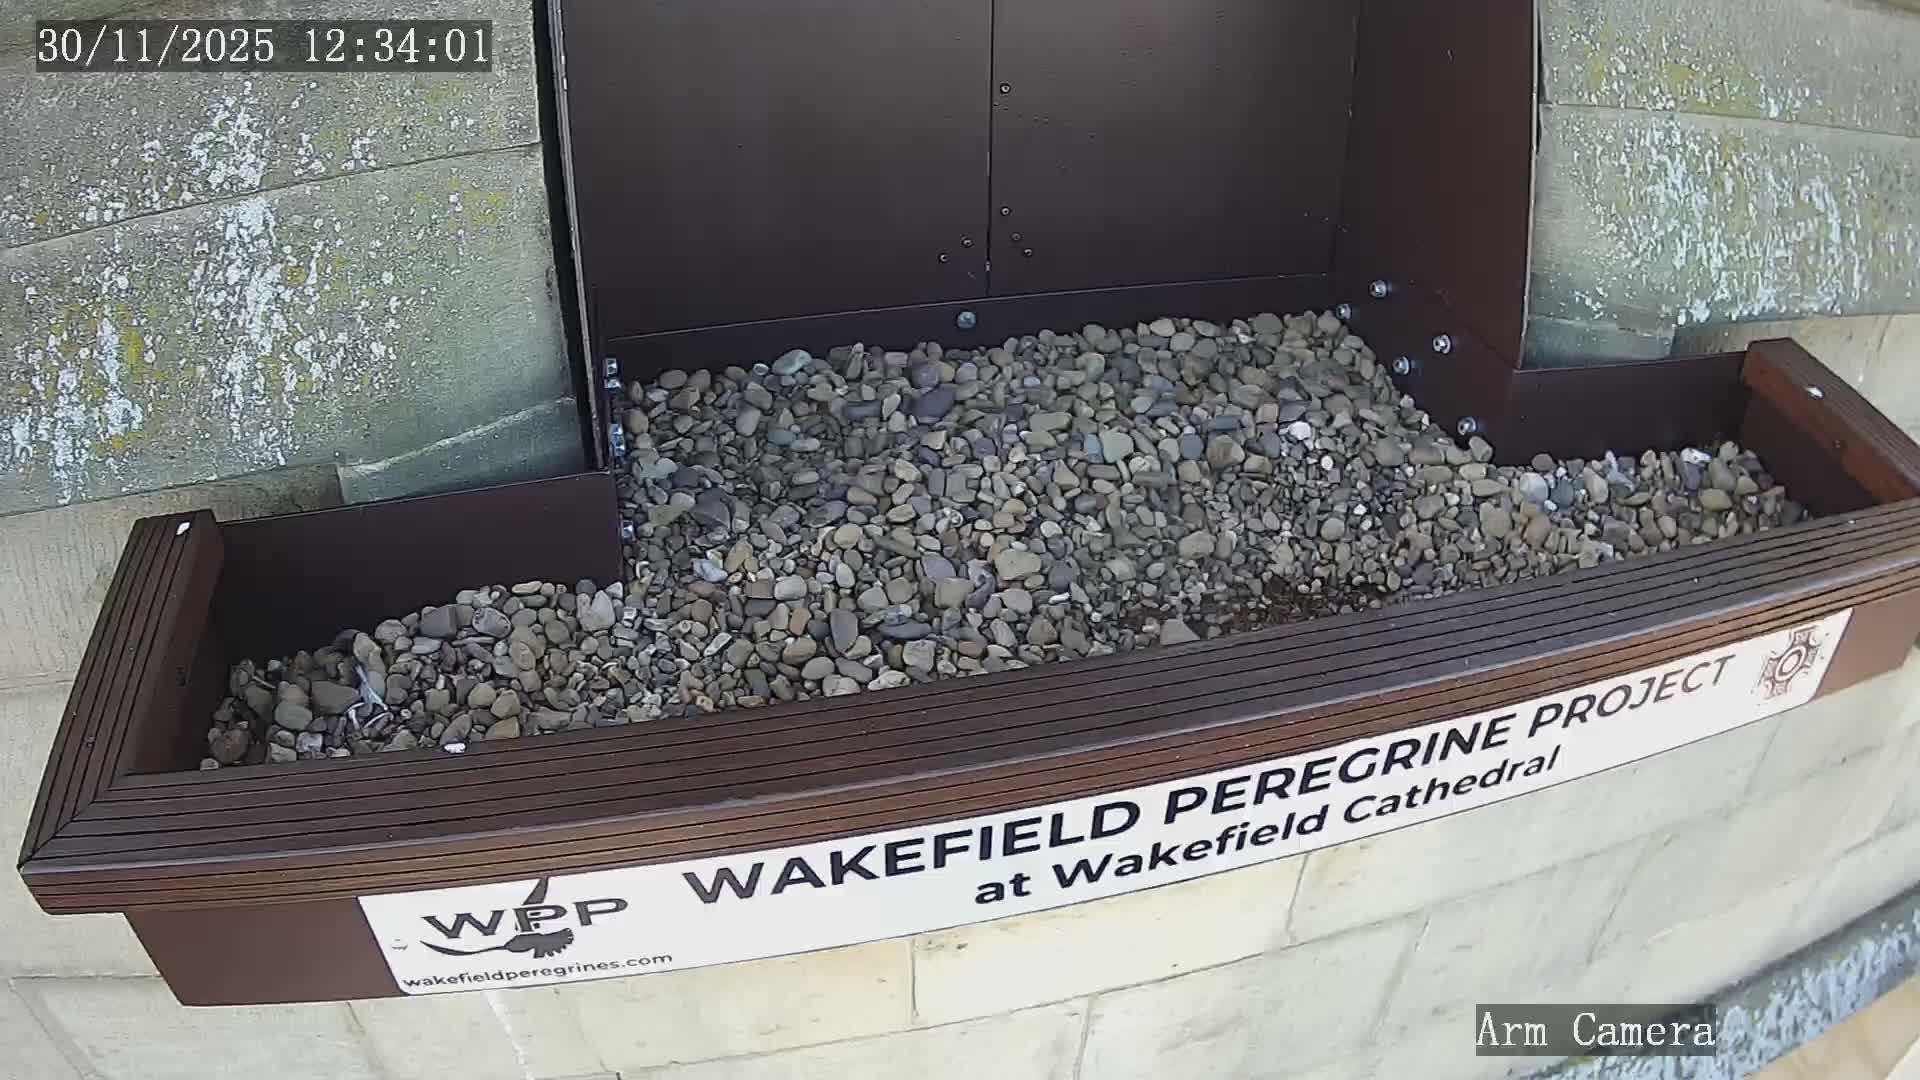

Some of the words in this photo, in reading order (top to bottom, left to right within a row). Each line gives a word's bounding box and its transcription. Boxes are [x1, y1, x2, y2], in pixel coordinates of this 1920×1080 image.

[682, 801, 1141, 905] WAKEFIELD
[1164, 712, 1517, 826] PEREGRINE
[1527, 653, 1736, 738] PROJECT
[974, 872, 1031, 905] at
[1052, 804, 1330, 889] Wakefield
[1342, 744, 1561, 826] Cathedral
[421, 897, 628, 939] WPP
[402, 952, 673, 988] wakefieldperegrines.com
